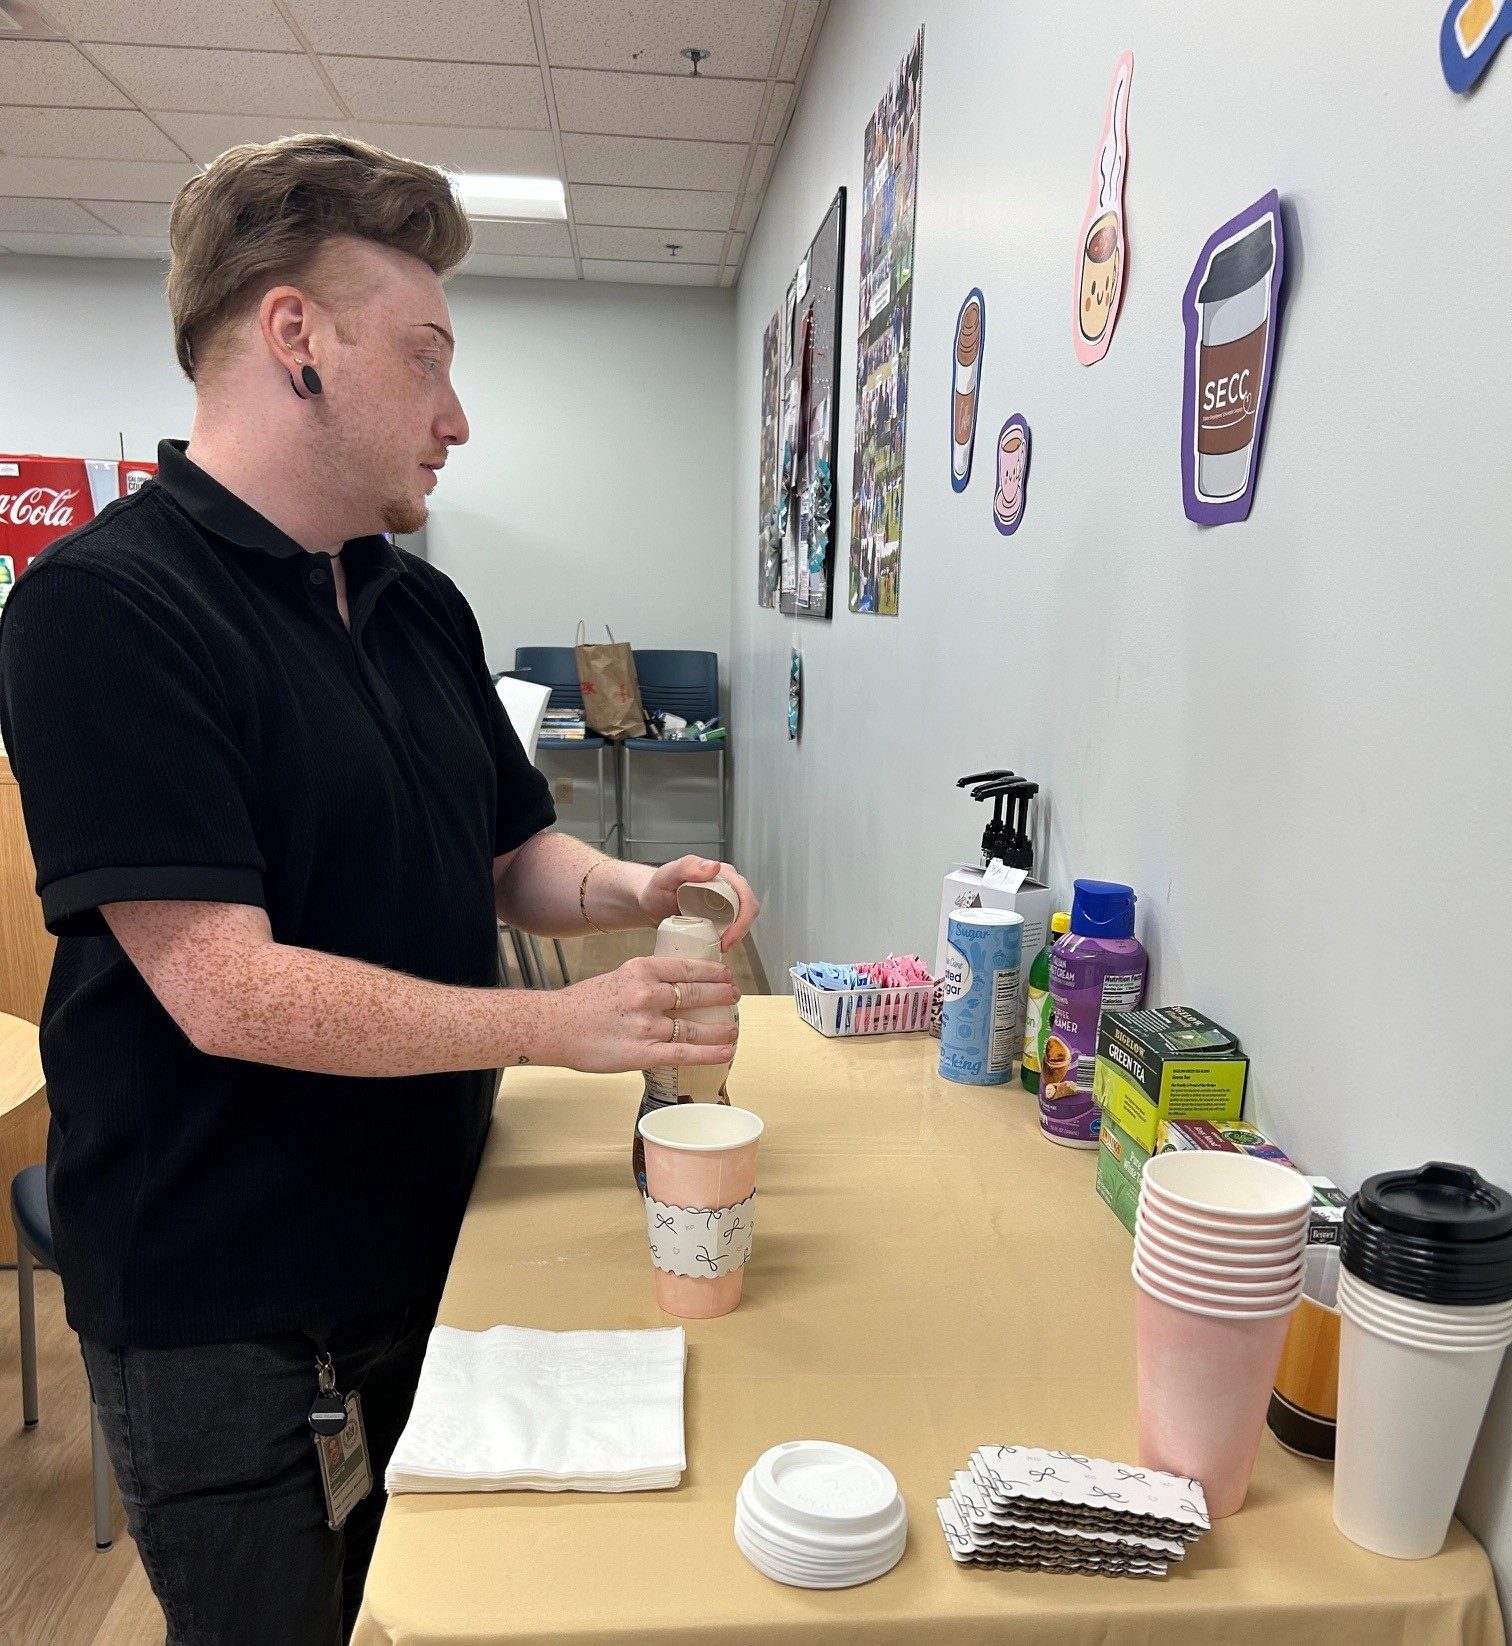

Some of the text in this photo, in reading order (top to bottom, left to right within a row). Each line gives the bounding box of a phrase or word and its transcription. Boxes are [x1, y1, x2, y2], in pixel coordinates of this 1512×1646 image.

[1202, 368, 1250, 411] SECC
[956, 923, 990, 941] Sugar
[1057, 966, 1075, 982] CREAM
[1104, 973, 1130, 983] Nutrition
[946, 983, 961, 996] gar
[1054, 1015, 1078, 1034] EAMER
[1114, 1029, 1146, 1058] BIGELOW
[1108, 1043, 1145, 1083] GREEN TEA
